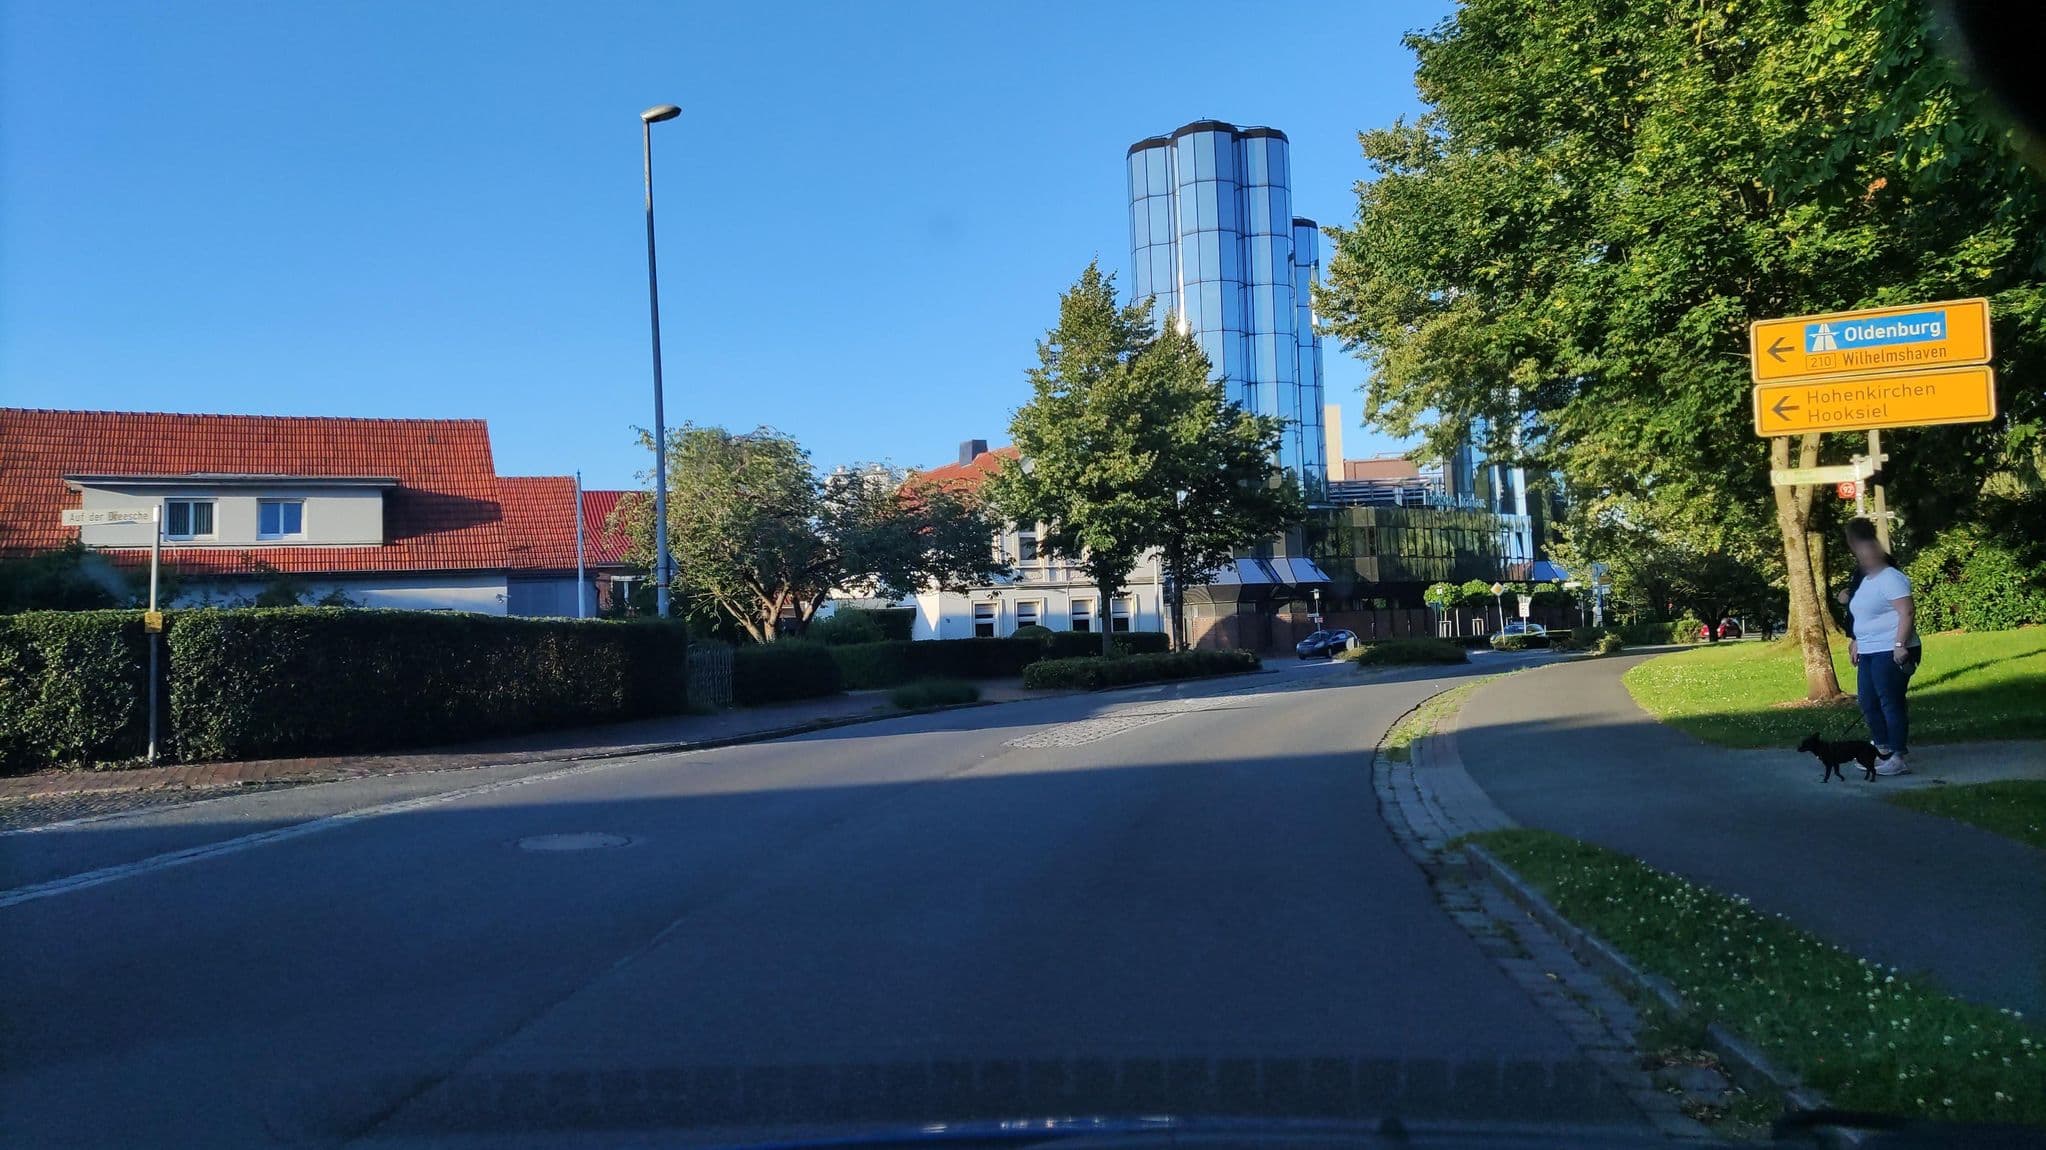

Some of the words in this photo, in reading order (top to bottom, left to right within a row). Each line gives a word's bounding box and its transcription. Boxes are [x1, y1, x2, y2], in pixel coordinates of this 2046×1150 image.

[1844, 322, 1941, 342] Oldenburg
[1810, 355, 1832, 368] 210
[1842, 346, 1947, 367] Wilhelmshaven
[1807, 383, 1936, 405] Hohenkirchen
[1807, 403, 1888, 423] Hooksiel
[70, 512, 85, 522] Auf
[89, 511, 104, 521] der
